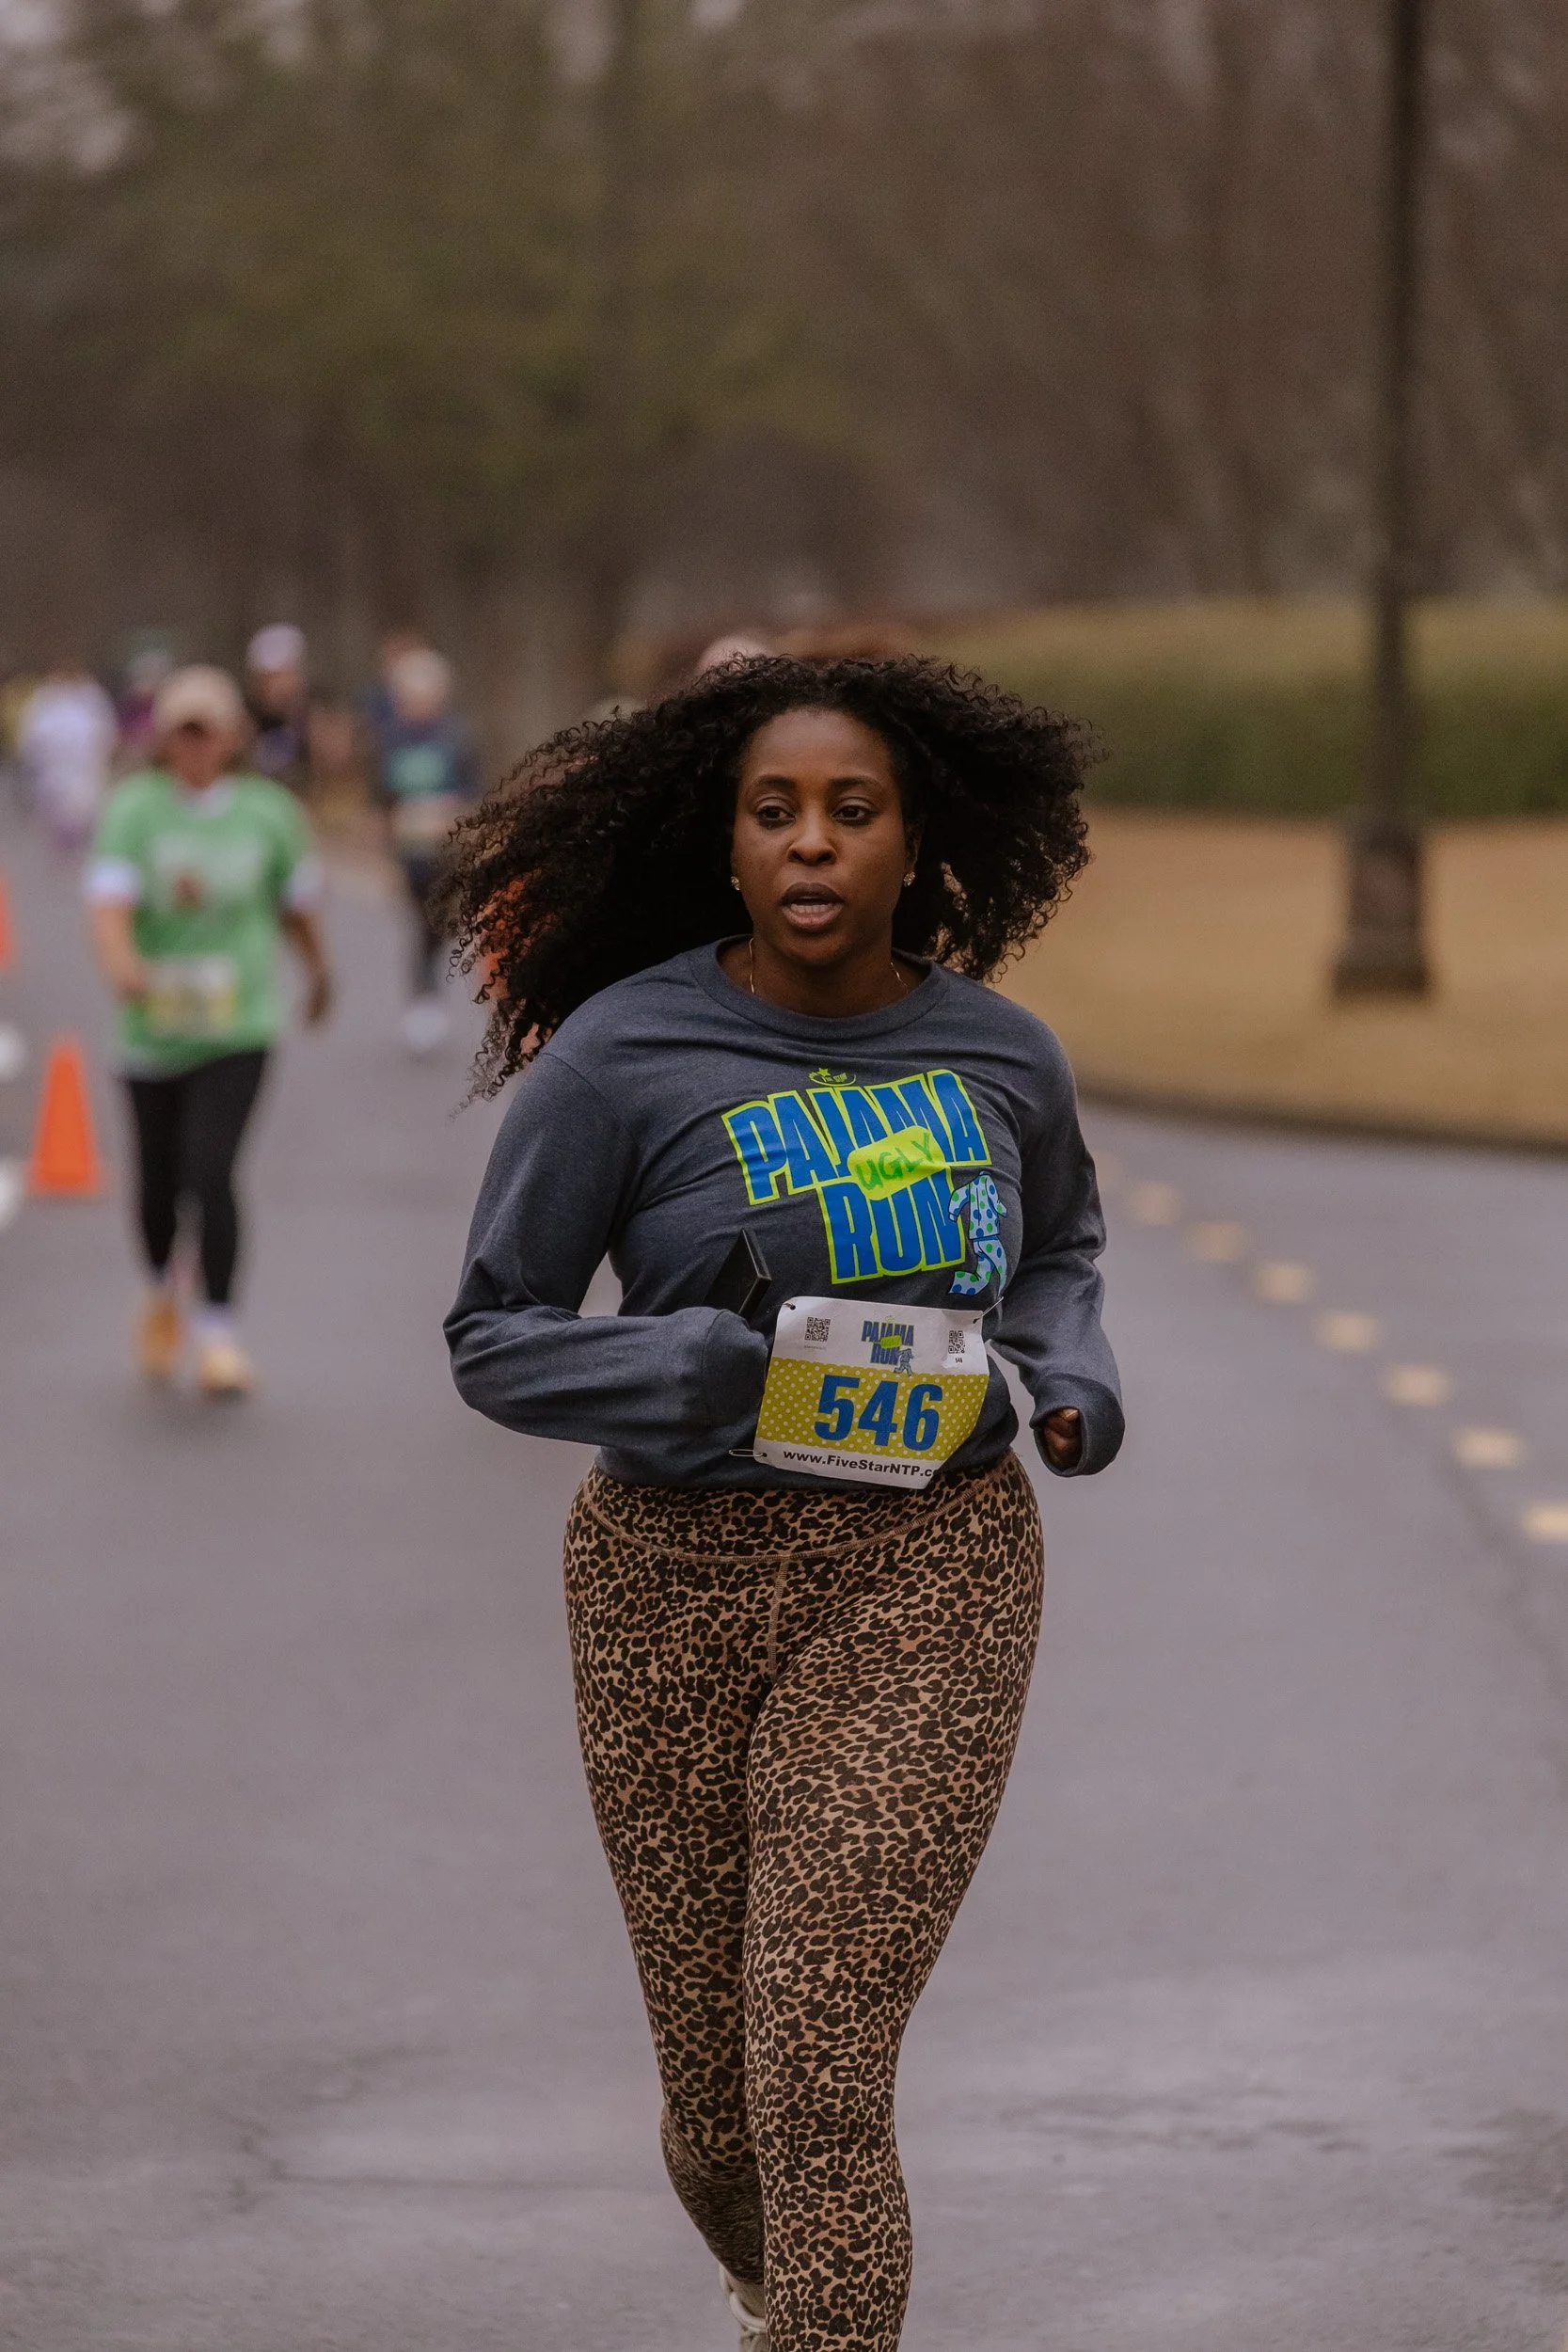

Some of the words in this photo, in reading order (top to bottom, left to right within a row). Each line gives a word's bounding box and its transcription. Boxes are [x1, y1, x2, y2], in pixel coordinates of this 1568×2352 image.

[722, 1069, 991, 1205] PAJAMA
[855, 1132, 931, 1191] UGLY
[816, 1166, 966, 1284] RUN
[814, 1374, 943, 1452] 546
